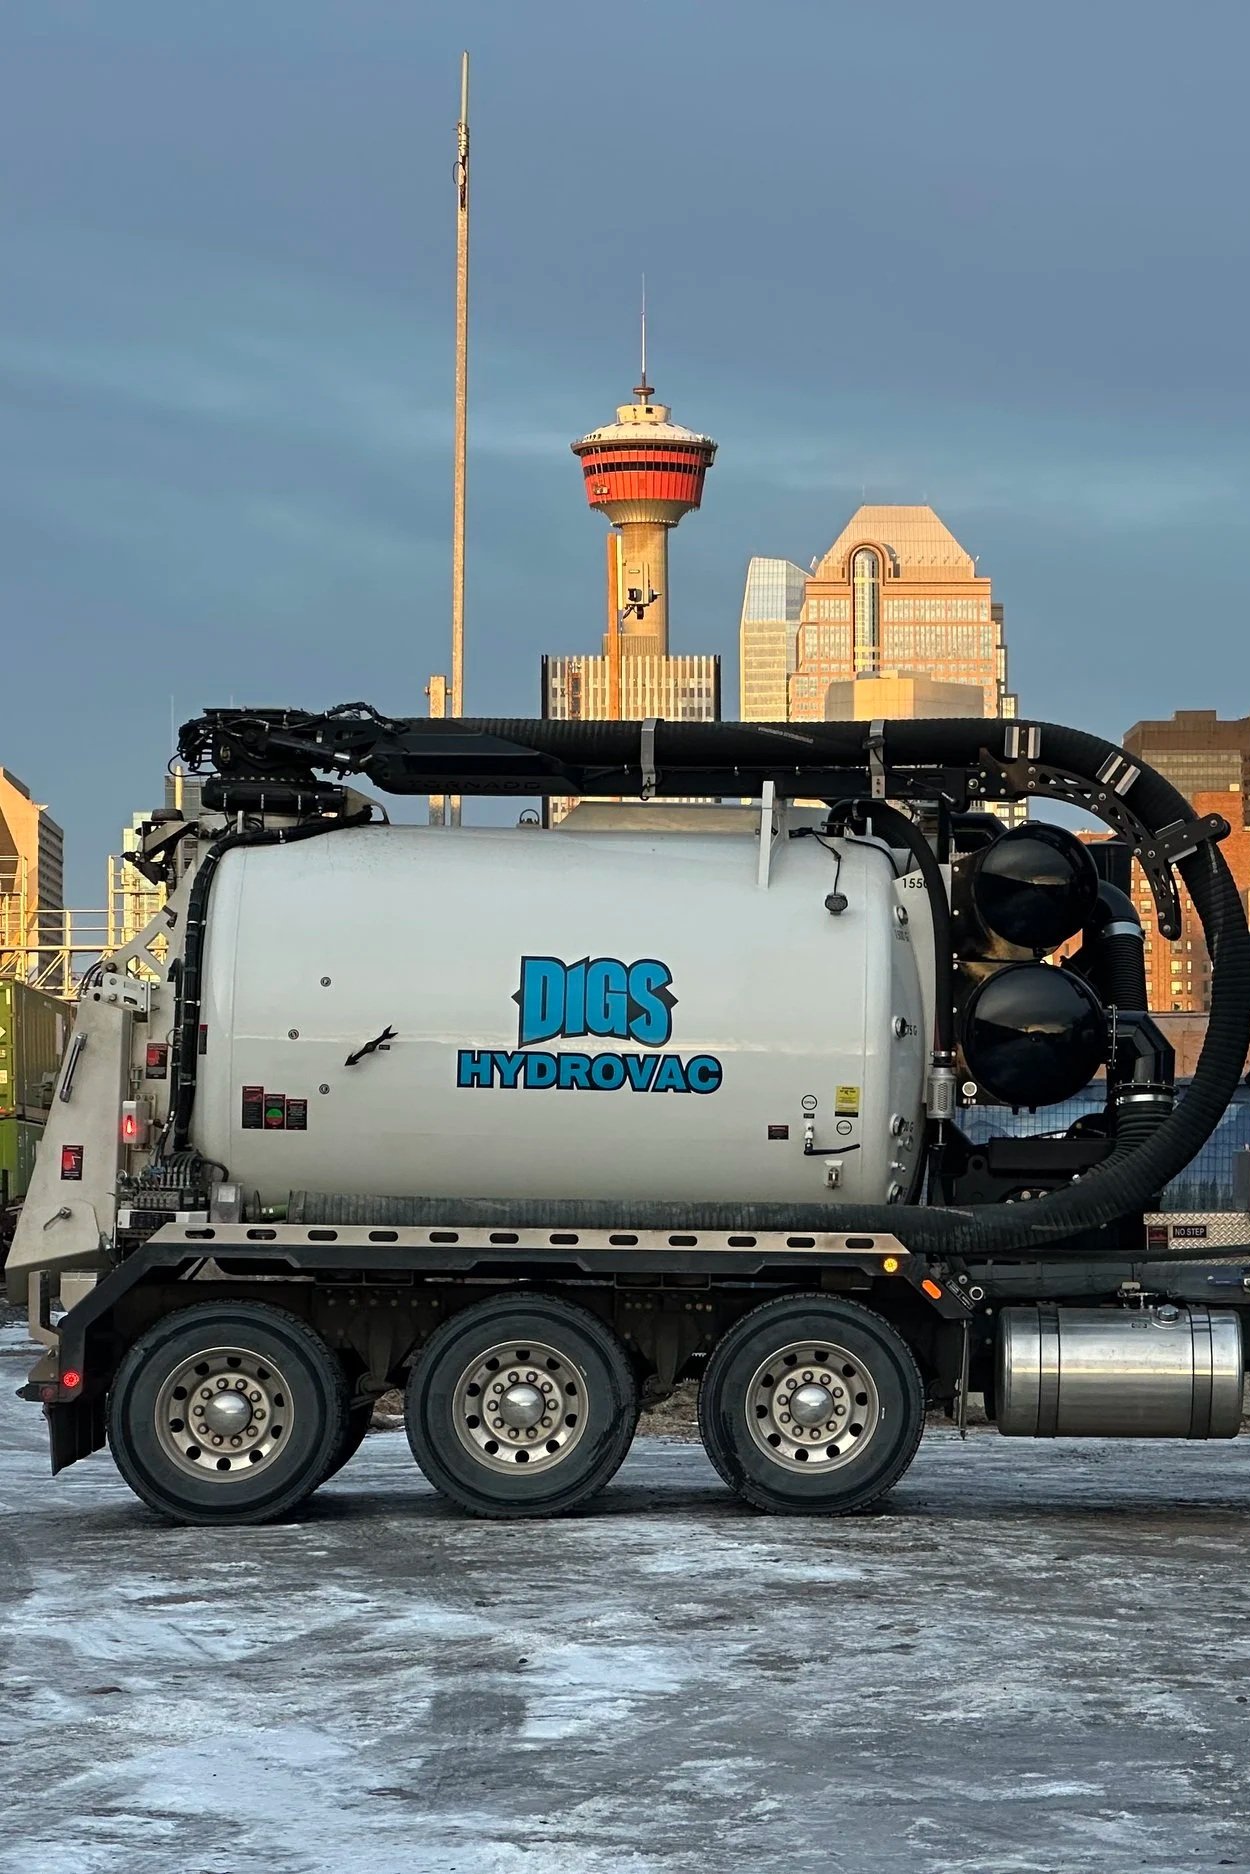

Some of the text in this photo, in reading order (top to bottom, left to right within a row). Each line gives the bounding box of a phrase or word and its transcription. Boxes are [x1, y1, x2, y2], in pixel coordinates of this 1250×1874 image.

[517, 956, 674, 1049] DIGS
[457, 1050, 723, 1094] HYDROVAC
[1175, 1228, 1185, 1236] NO
[1186, 1228, 1205, 1236] STEP
